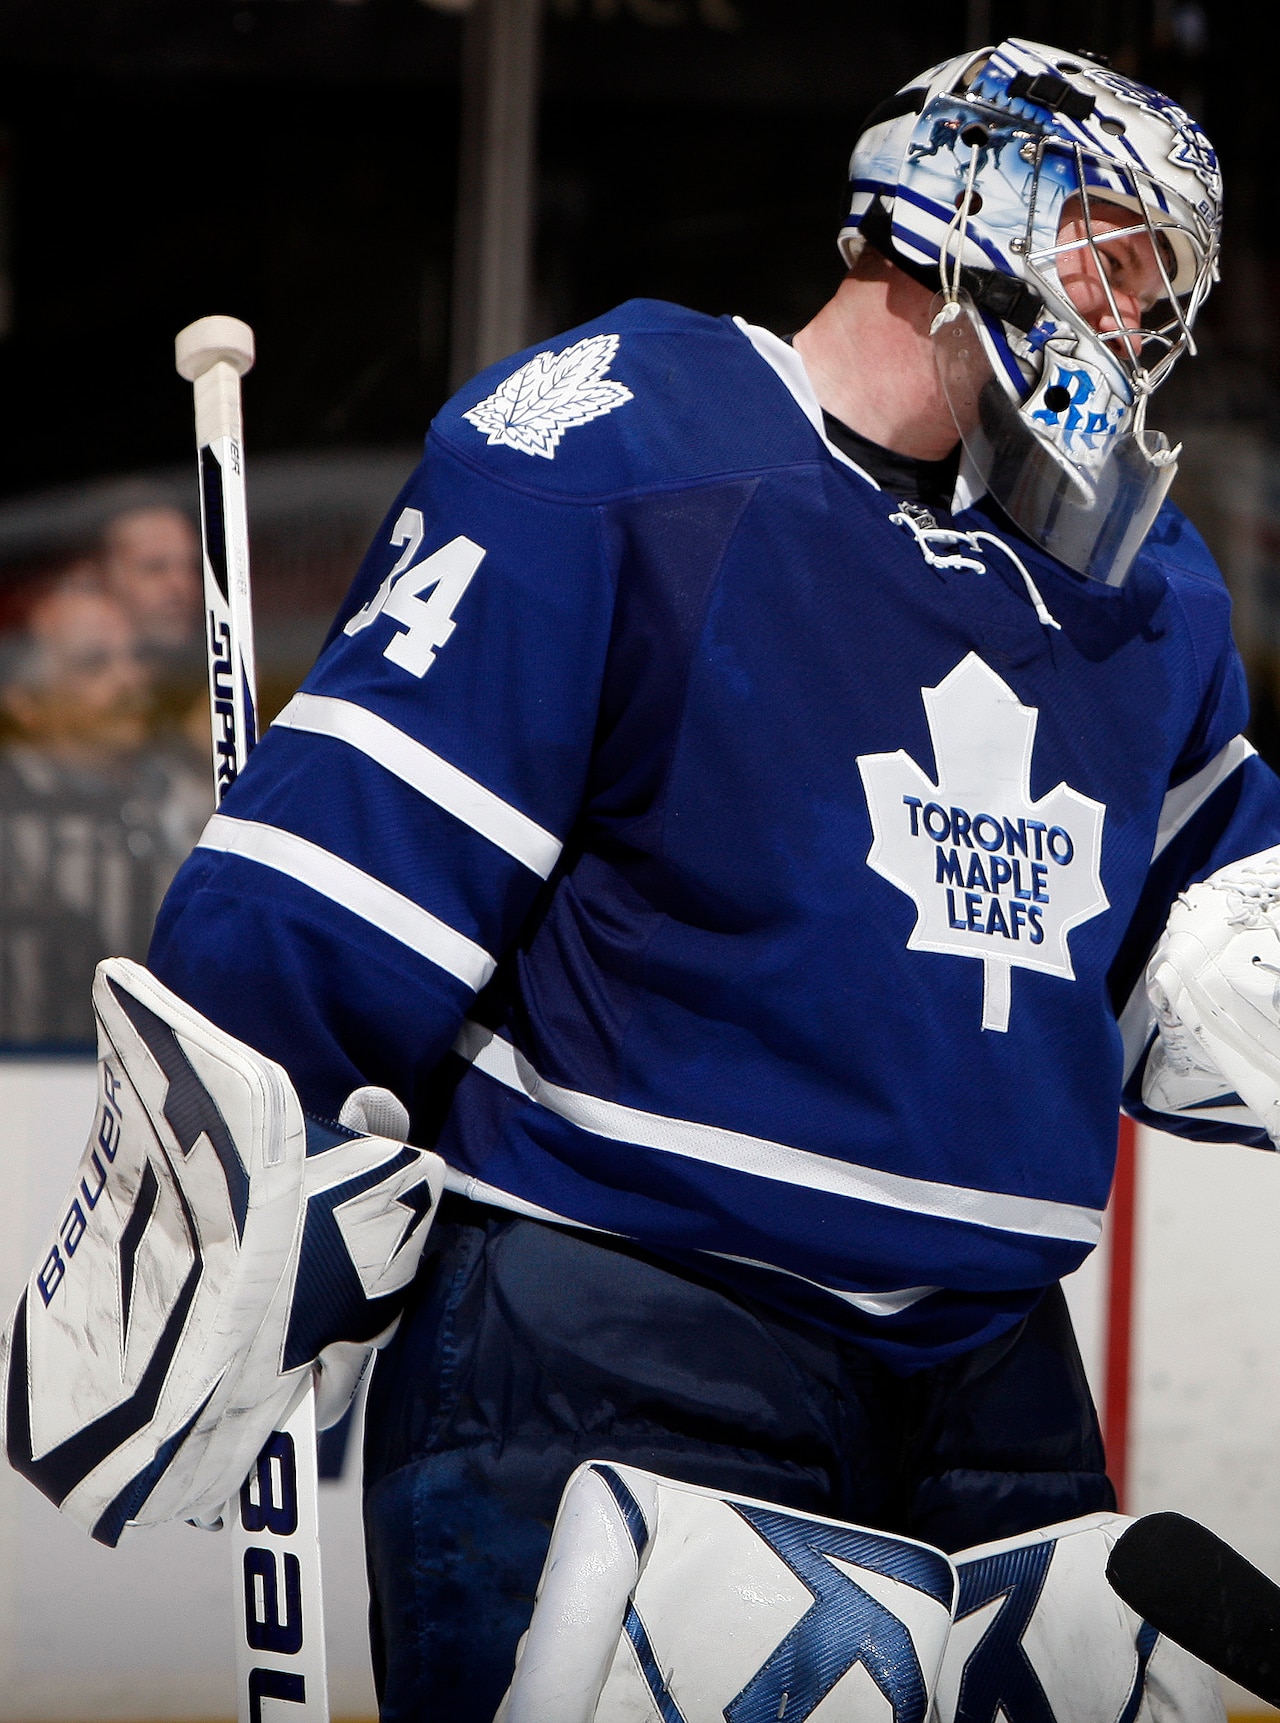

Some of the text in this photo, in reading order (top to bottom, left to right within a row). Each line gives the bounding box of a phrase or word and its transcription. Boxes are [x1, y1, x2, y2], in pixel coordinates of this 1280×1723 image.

[343, 506, 487, 679] 34
[902, 794, 1075, 866] TORONTO
[935, 845, 1050, 904] MAPLE
[946, 888, 1045, 945] LEAFS
